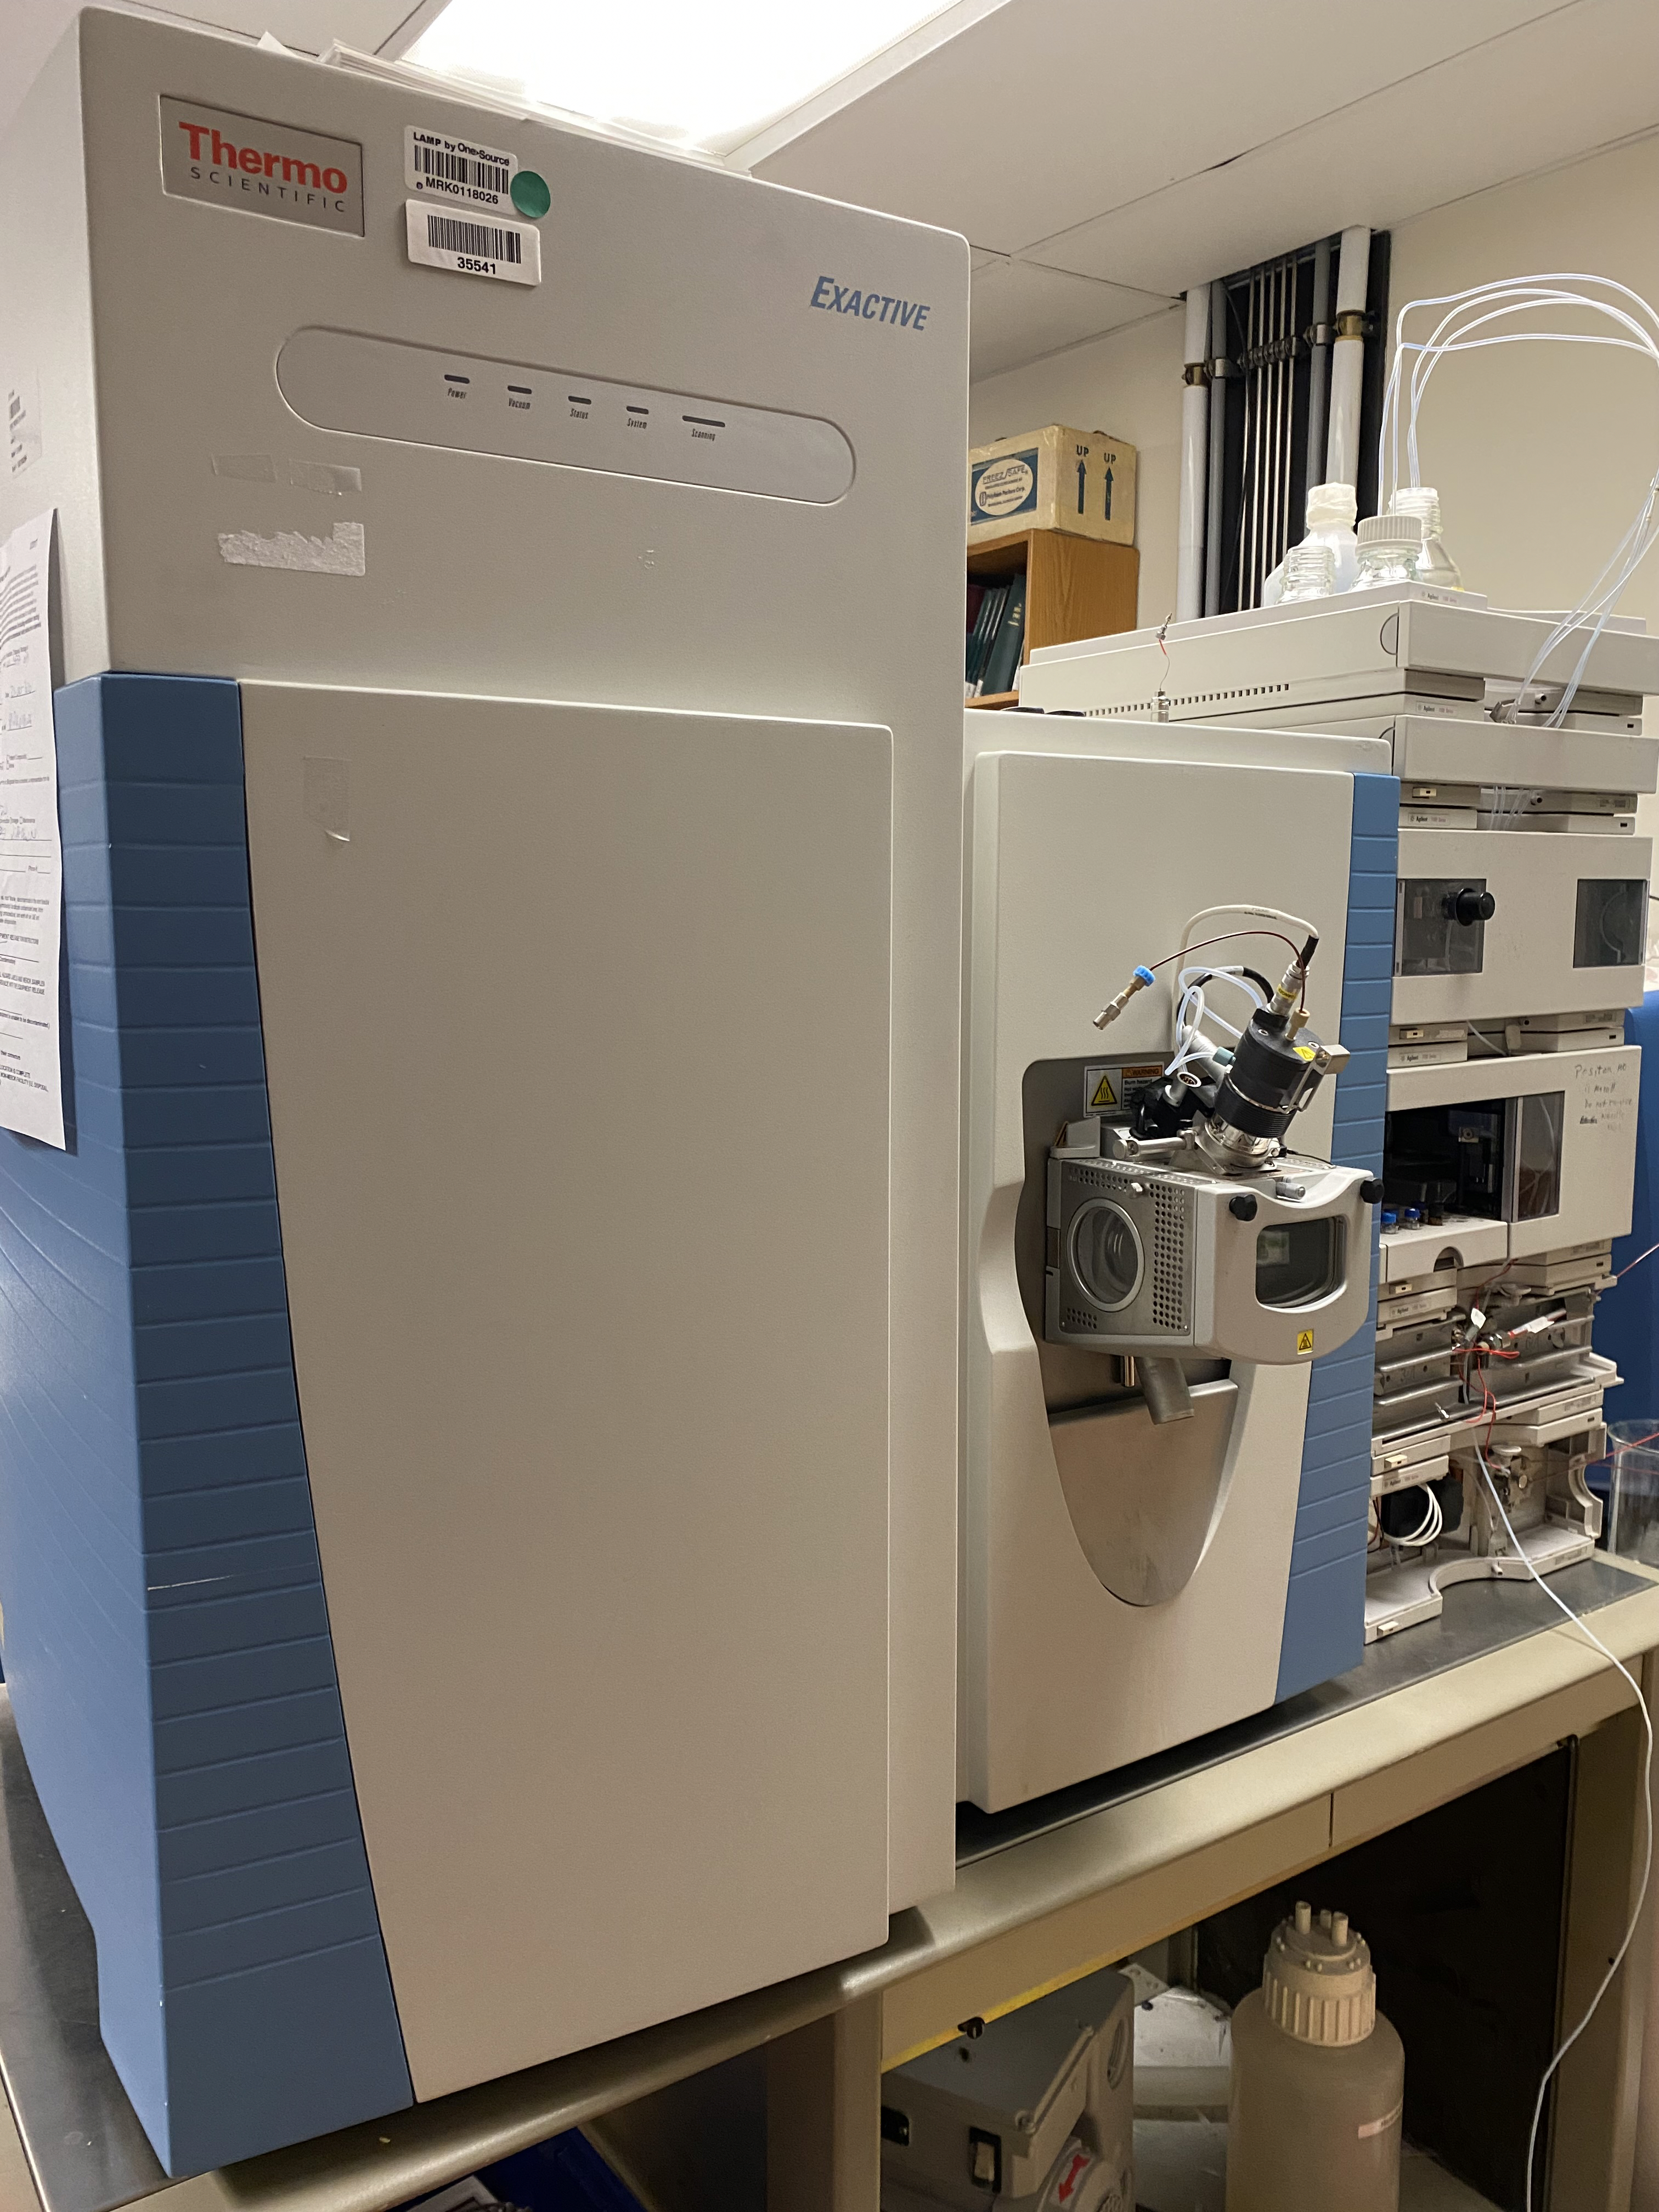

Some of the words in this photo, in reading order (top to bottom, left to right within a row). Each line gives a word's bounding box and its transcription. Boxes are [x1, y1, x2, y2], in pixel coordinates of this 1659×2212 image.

[413, 132, 441, 146] LAMP
[444, 140, 455, 152] by
[179, 121, 347, 194] Thermo
[190, 167, 345, 212] SCIENTIFIC
[426, 176, 499, 205] MRK0118026
[457, 256, 496, 275] 35541
[810, 275, 931, 331] EXACTIVE
[447, 387, 467, 399] Power
[509, 398, 531, 410] Vacuum
[570, 408, 589, 420] Status
[627, 417, 647, 429] System
[691, 428, 716, 442] Scanning
[1076, 444, 1089, 458] UP
[1104, 452, 1116, 465] UP
[1132, 1068, 1159, 1076] WARNING
